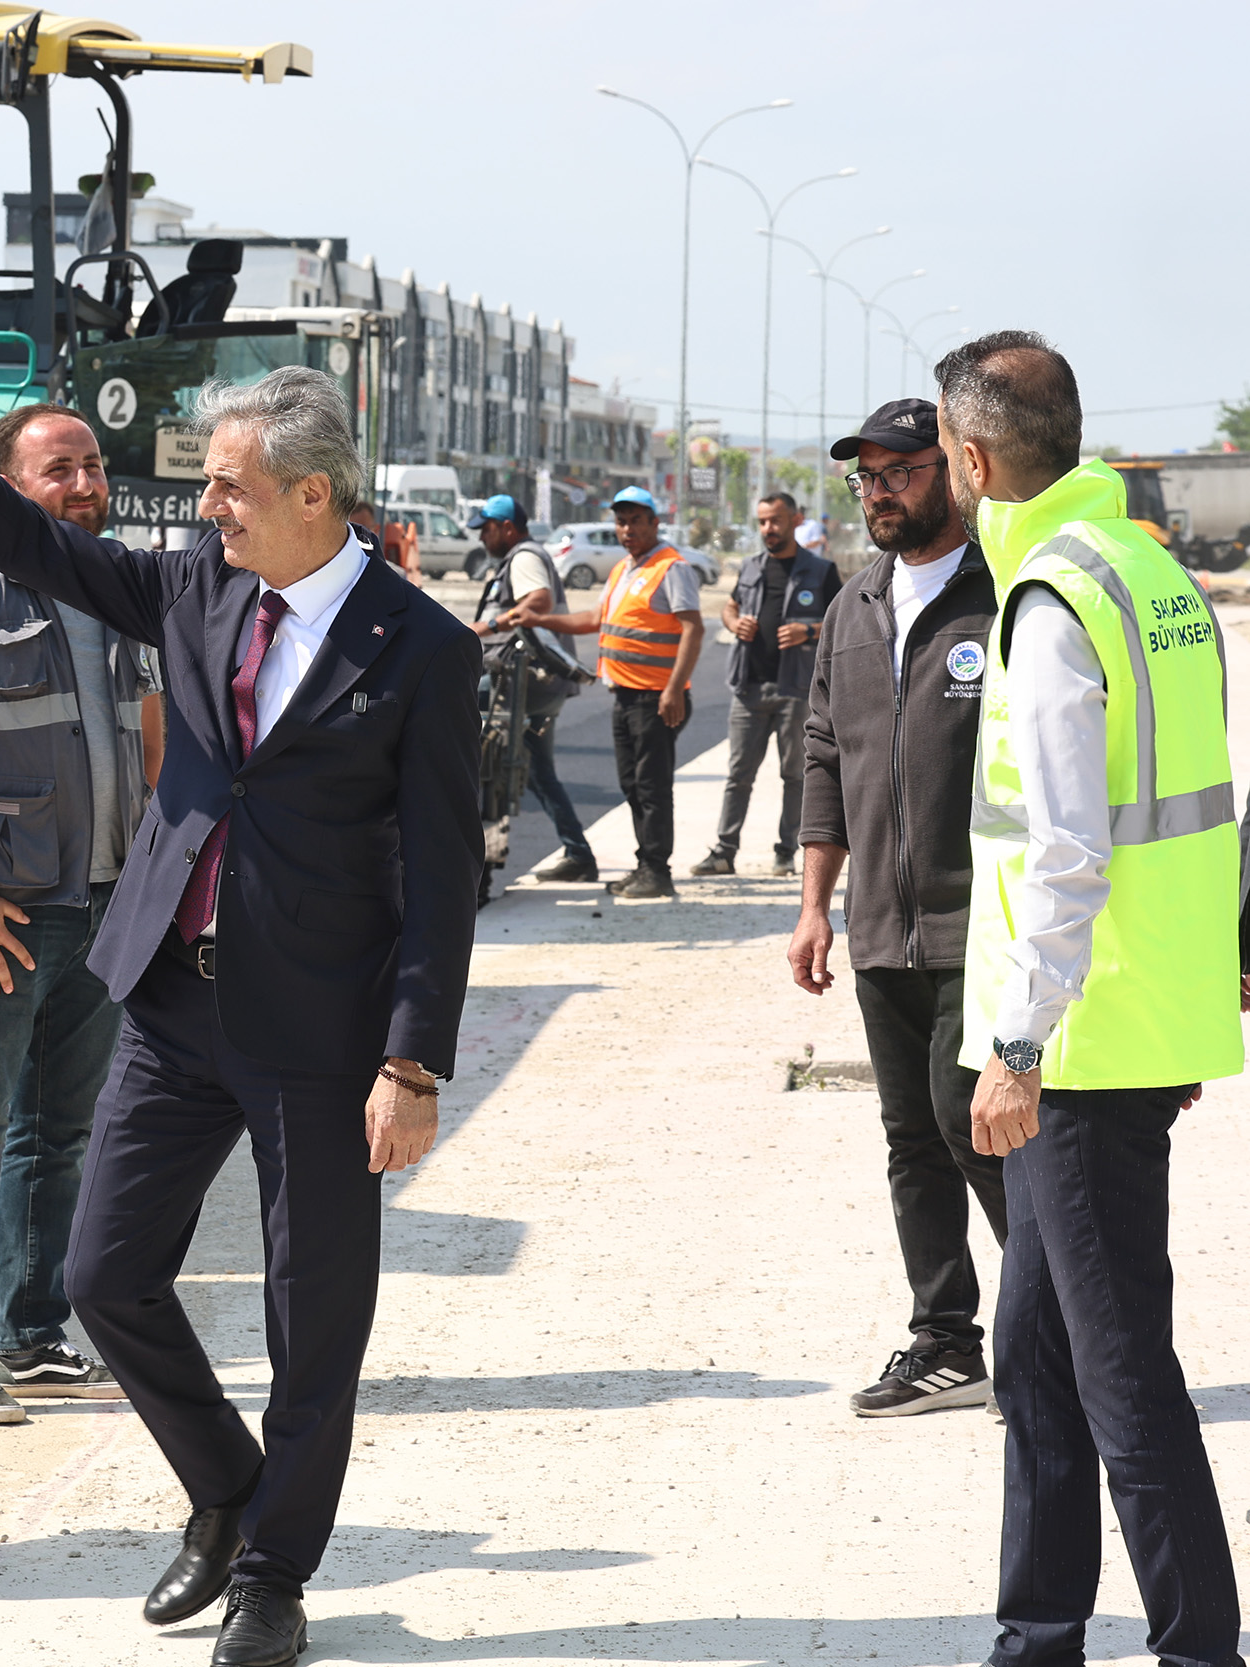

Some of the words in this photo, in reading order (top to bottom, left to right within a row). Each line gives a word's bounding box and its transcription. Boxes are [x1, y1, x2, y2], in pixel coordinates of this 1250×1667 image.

[108, 385, 126, 422] 2
[892, 420, 916, 430] adidas
[176, 440, 200, 453] FAZLA
[108, 485, 214, 523] ÜKŞEHİ
[1151, 593, 1201, 620] SAKARYA
[950, 683, 982, 691] SAKARYA
